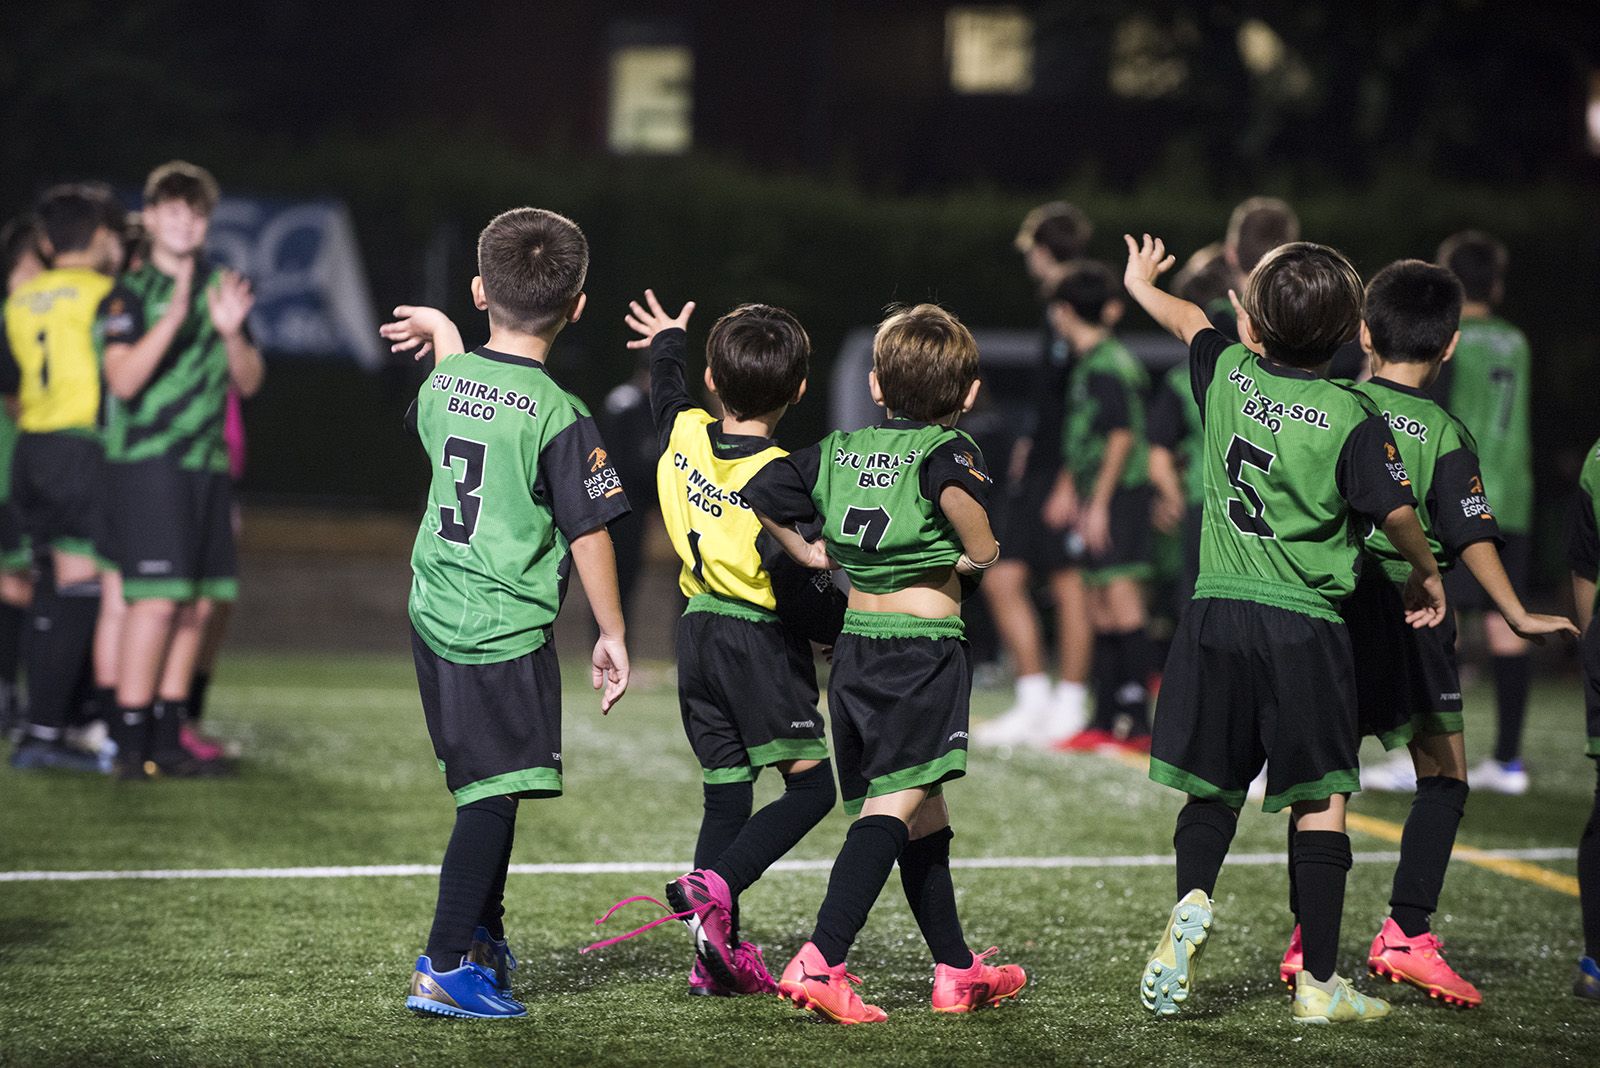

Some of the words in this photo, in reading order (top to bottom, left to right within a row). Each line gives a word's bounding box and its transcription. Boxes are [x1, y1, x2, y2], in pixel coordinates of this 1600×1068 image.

[447, 396, 496, 422] BACO
[454, 377, 537, 419] MIRA-SOL
[435, 434, 488, 547] 3
[1225, 433, 1276, 539] 5
[841, 504, 893, 552] 7
[687, 528, 707, 586] 1
